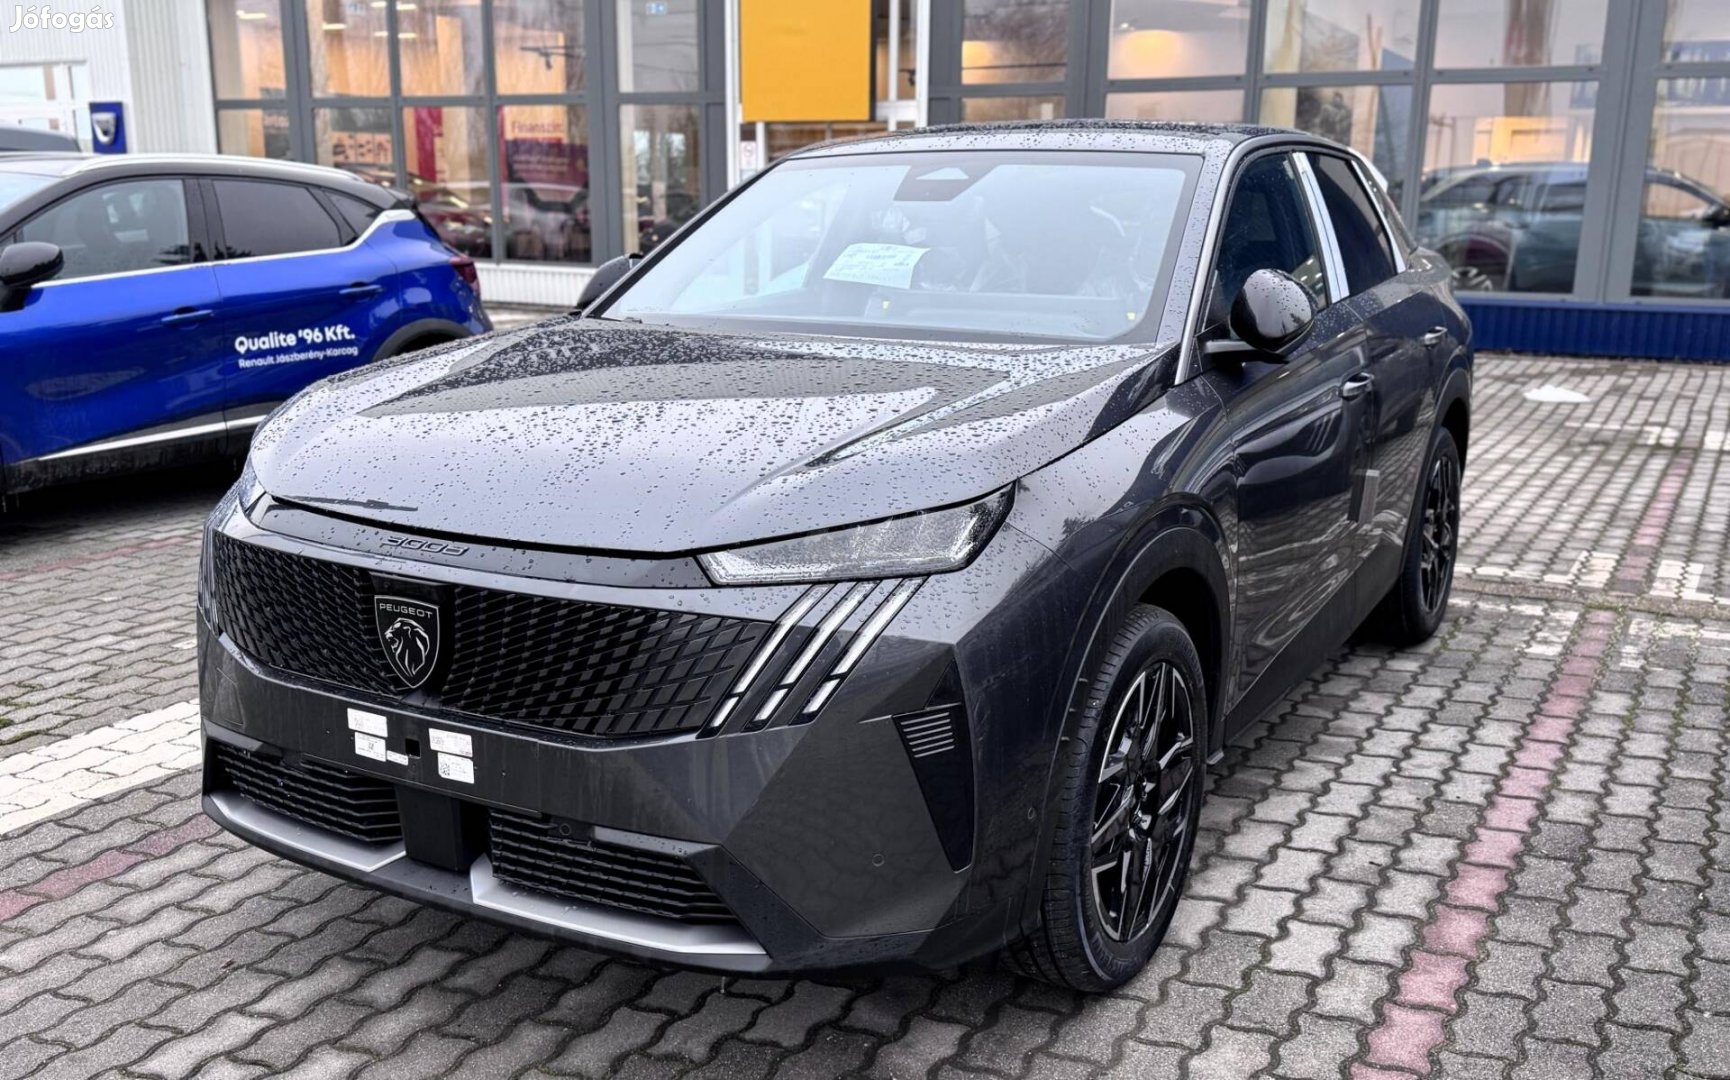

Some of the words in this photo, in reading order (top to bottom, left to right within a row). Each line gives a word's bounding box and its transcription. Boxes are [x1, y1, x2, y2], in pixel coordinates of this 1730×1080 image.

[234, 331, 297, 354] Qualite
[324, 324, 356, 342] Kft.
[238, 355, 275, 369] Renault
[275, 346, 359, 364] Jászberény-Karcag
[379, 535, 470, 557] 3008
[379, 602, 433, 619] PEUGEOT
